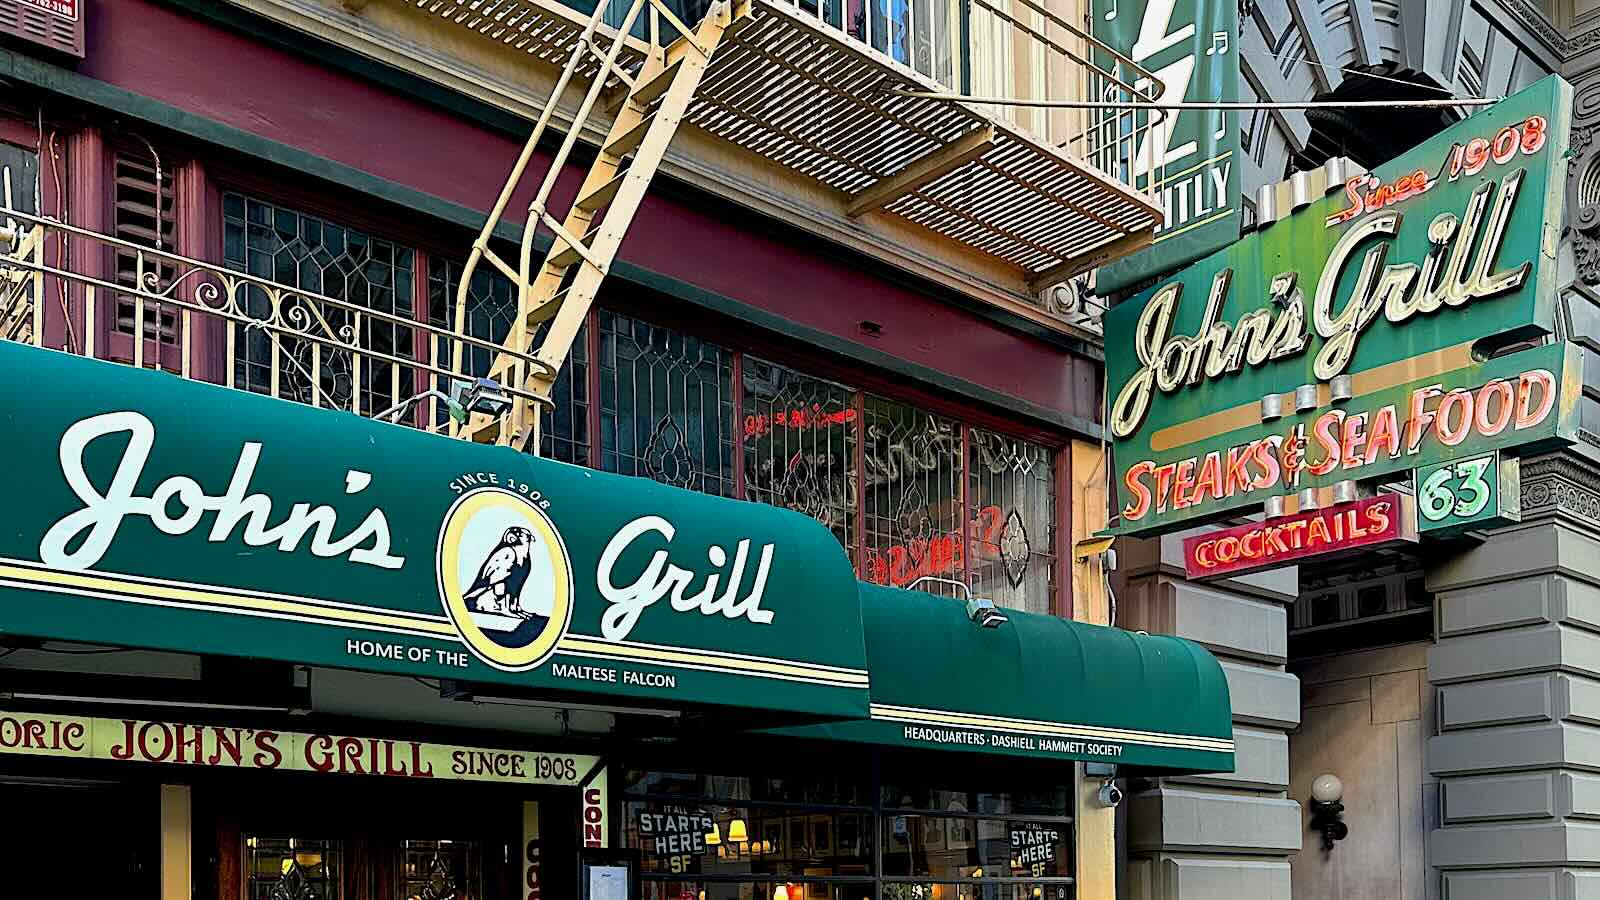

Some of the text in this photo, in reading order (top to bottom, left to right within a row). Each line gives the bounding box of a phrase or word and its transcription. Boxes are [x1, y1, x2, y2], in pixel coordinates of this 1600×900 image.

[1325, 115, 1547, 227] Since 1908
[1111, 167, 1531, 438] John's Grill
[1122, 434, 1284, 521] STEAKS
[1283, 423, 1310, 487] &
[449, 472, 551, 510] SINCE 1908
[1419, 455, 1494, 521] 63
[40, 411, 405, 571] John's
[597, 515, 775, 642] Grill
[1195, 501, 1392, 569] COCKTAILS
[347, 639, 469, 668] HOME OF THE
[552, 663, 676, 688] MALTESE FALCON
[110, 719, 283, 769] JOHN'S
[304, 734, 434, 777] GRILL
[451, 750, 527, 777] SINCE
[534, 755, 578, 781] 1908
[904, 726, 1123, 757] HEADQUARTERS DASHIELL HAMMETT SOCIETY
[640, 813, 712, 832] STARTS
[674, 805, 688, 815] ALL
[655, 831, 703, 855] HERE
[1011, 830, 1059, 846] STARTS
[1021, 842, 1053, 863] HERE
[670, 854, 691, 874] SF
[1031, 862, 1046, 877] SF
